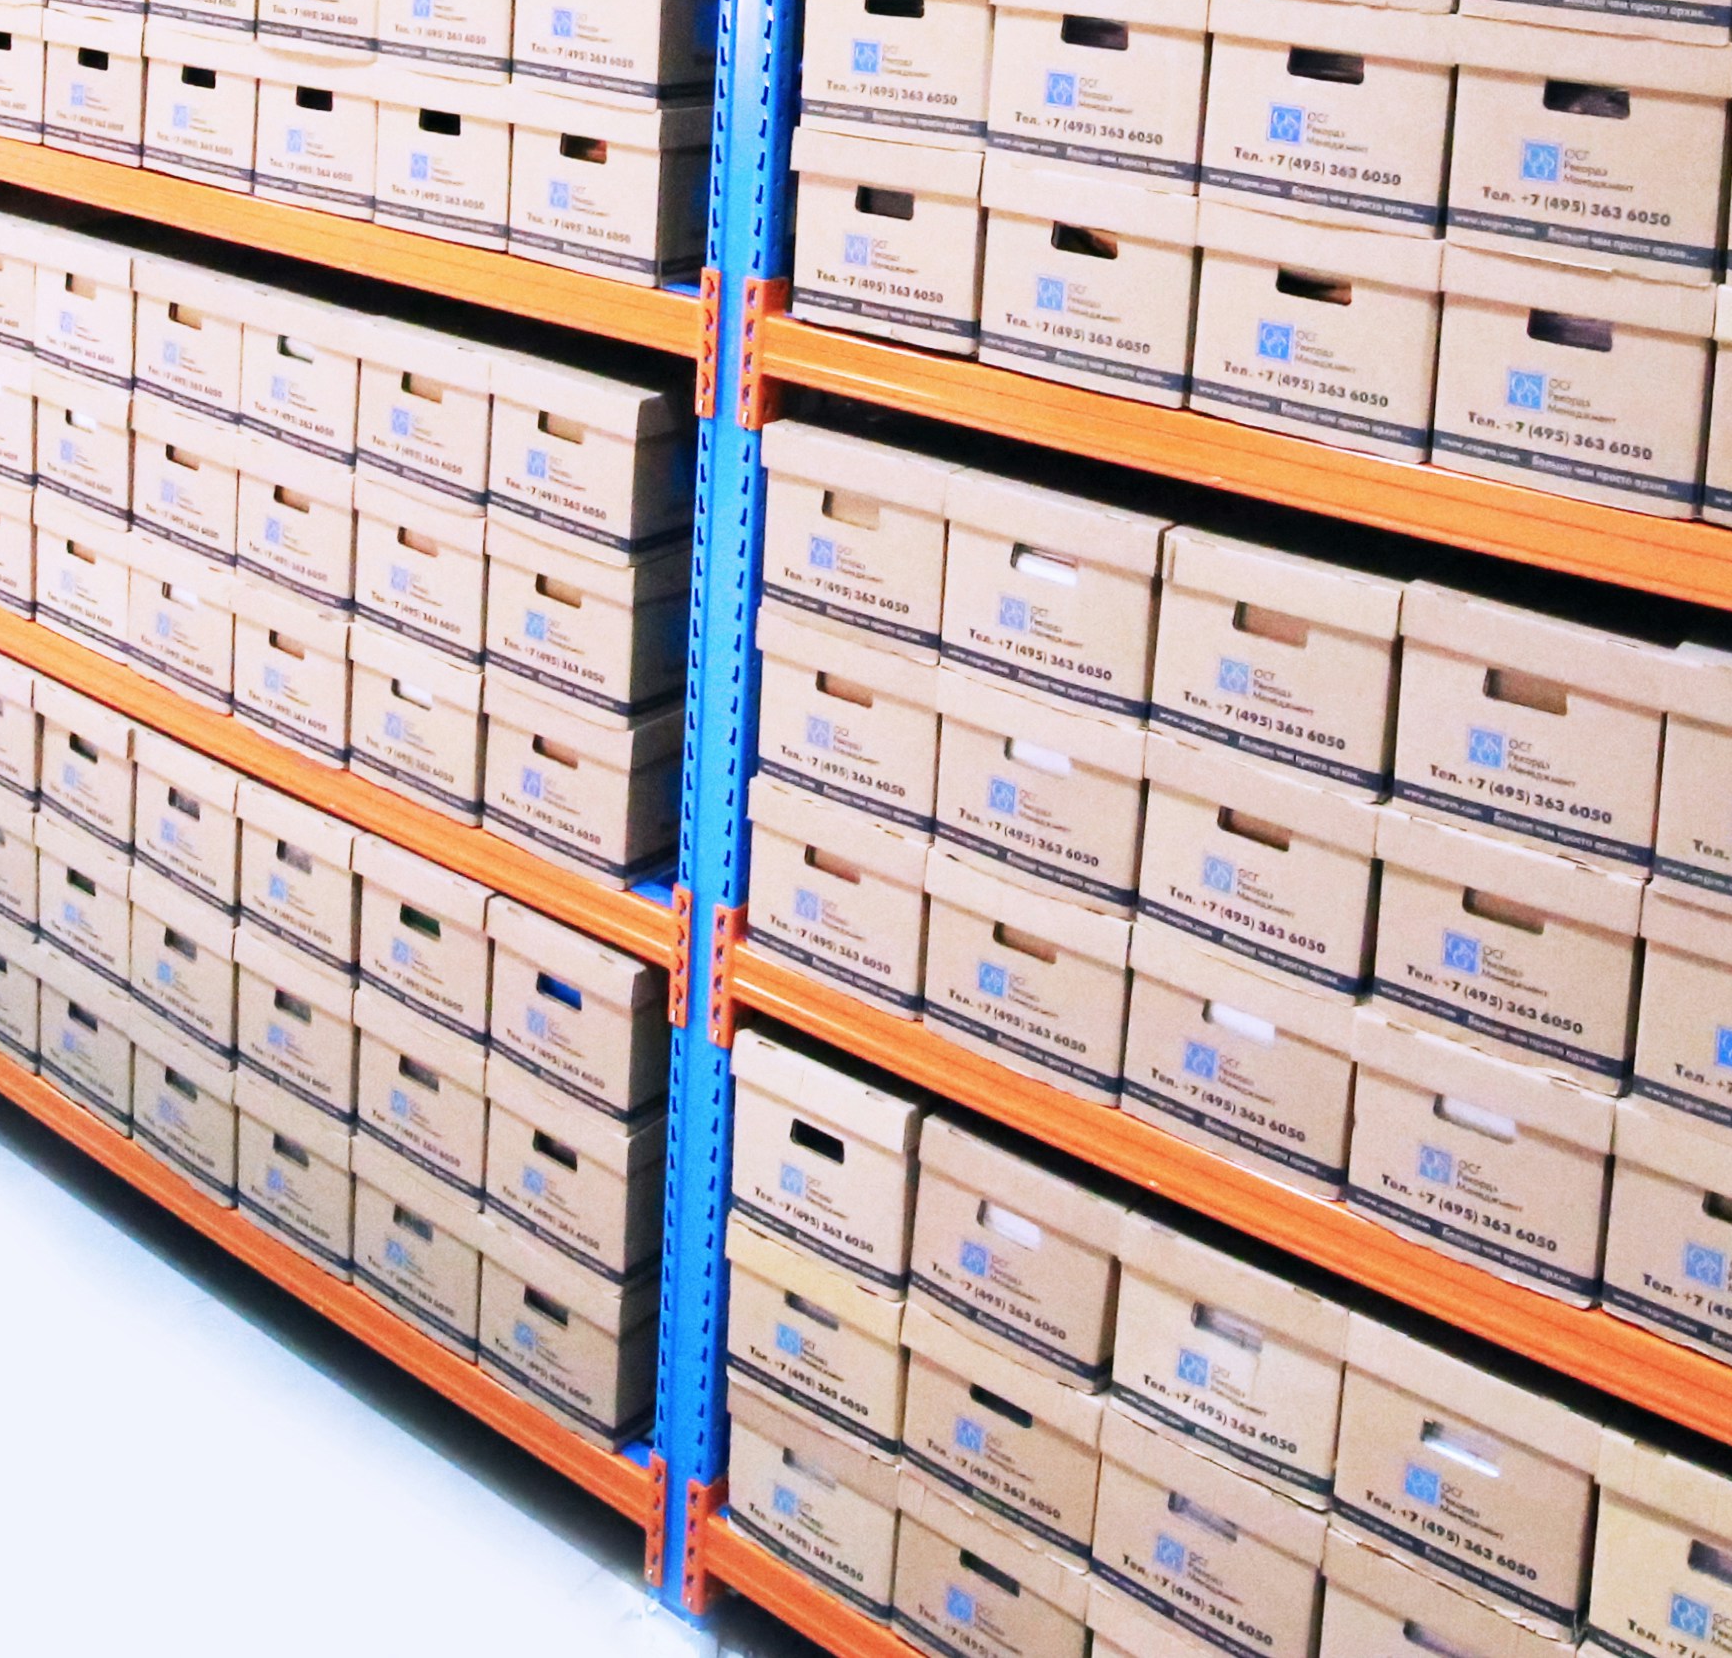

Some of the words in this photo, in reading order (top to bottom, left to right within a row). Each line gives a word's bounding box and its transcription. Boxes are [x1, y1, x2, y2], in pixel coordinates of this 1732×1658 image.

[783, 567, 805, 583] Тел.
[824, 580, 851, 600] (495)
[854, 589, 875, 605] 363
[879, 597, 909, 615] 6050
[1429, 764, 1461, 784] Тел.
[1467, 775, 1486, 791] +7
[1489, 780, 1530, 805] (495)
[1534, 793, 1565, 812] 363
[1569, 803, 1612, 825] 6050
[1365, 1489, 1396, 1514] Тел.
[1400, 1507, 1419, 1525] +7
[1421, 1516, 1460, 1547] (495)
[1463, 1537, 1492, 1561] 363
[1496, 1553, 1537, 1582] 6050
